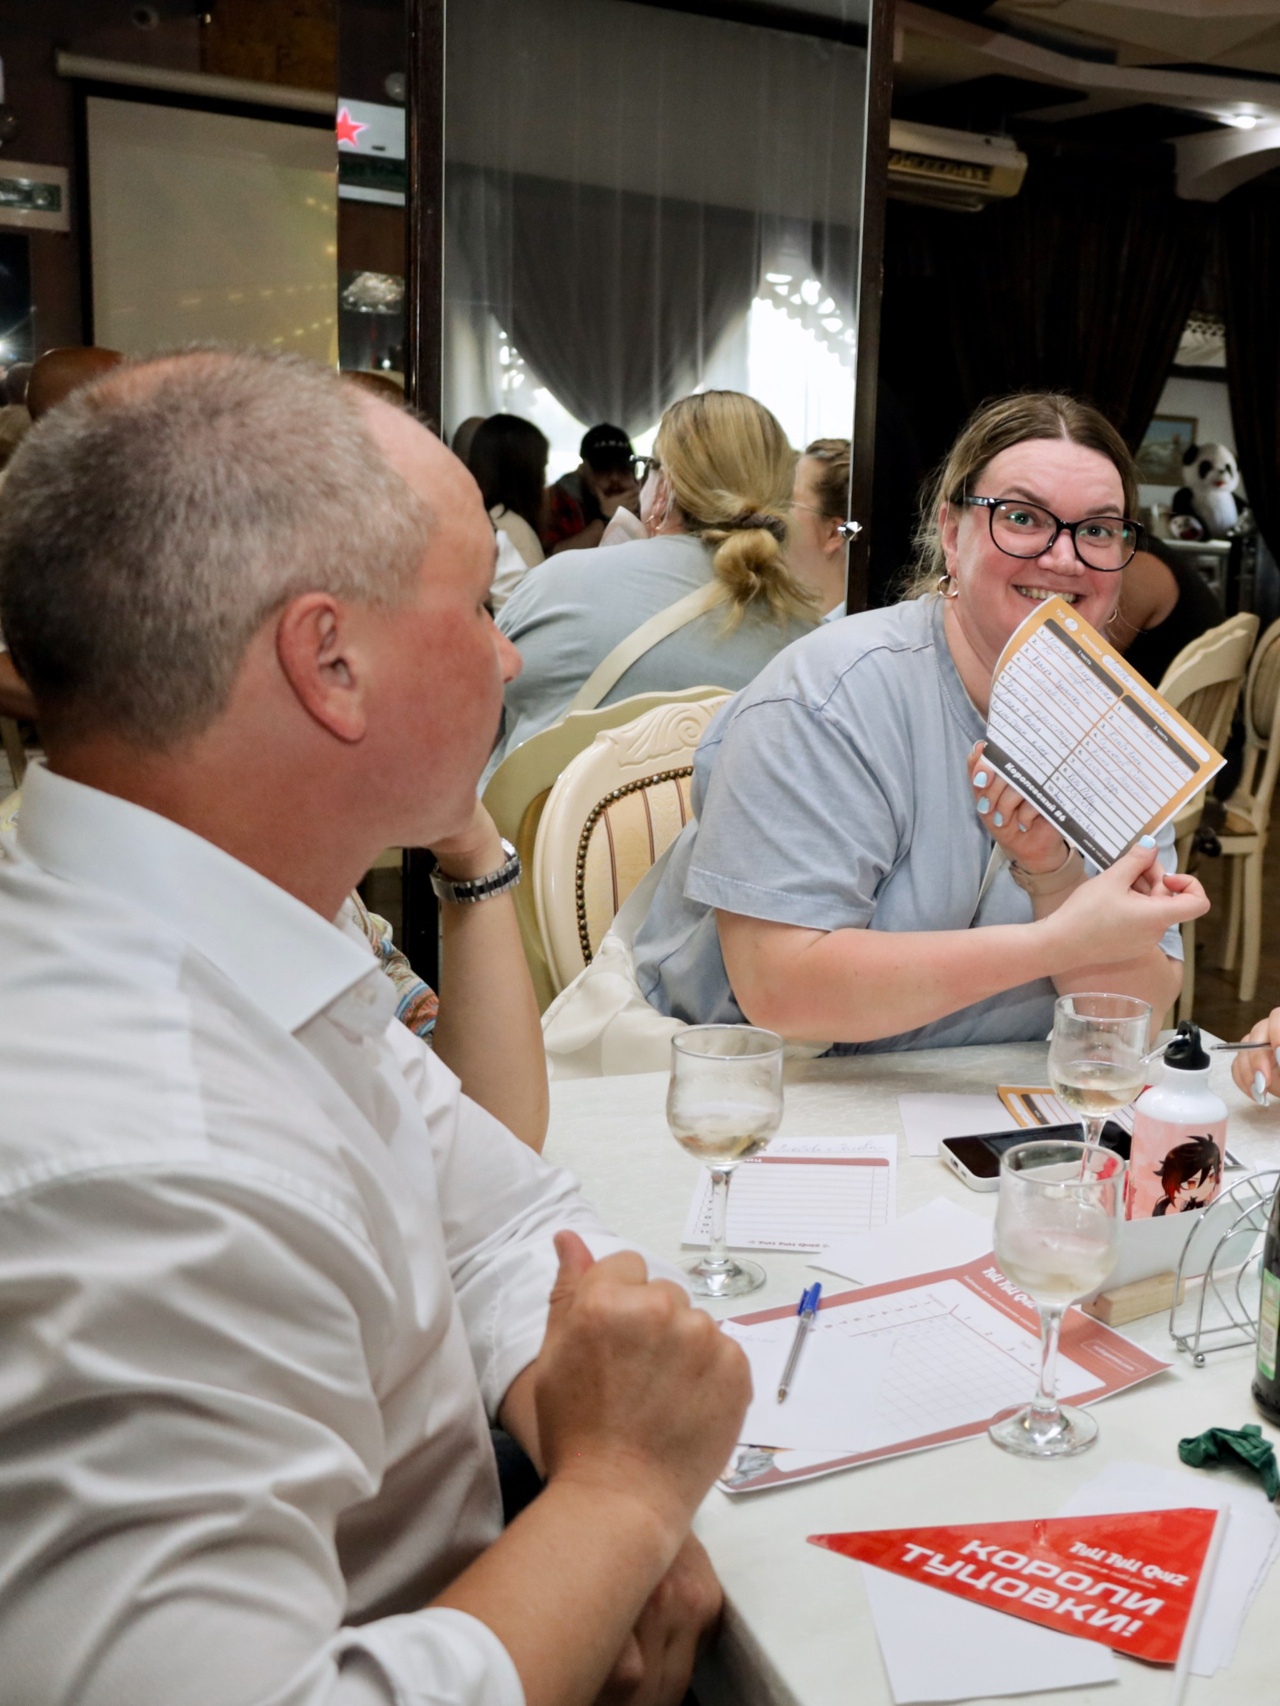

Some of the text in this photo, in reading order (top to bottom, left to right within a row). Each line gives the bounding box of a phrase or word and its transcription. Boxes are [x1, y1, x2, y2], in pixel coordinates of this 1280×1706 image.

[1081, 653, 1092, 666] часть
[1157, 729, 1168, 742] часть
[1004, 762, 1056, 813] Королевский
[901, 1542, 1144, 1638] ТУЦОВКИ!
[959, 1540, 1165, 1616] КОРОЛИ
